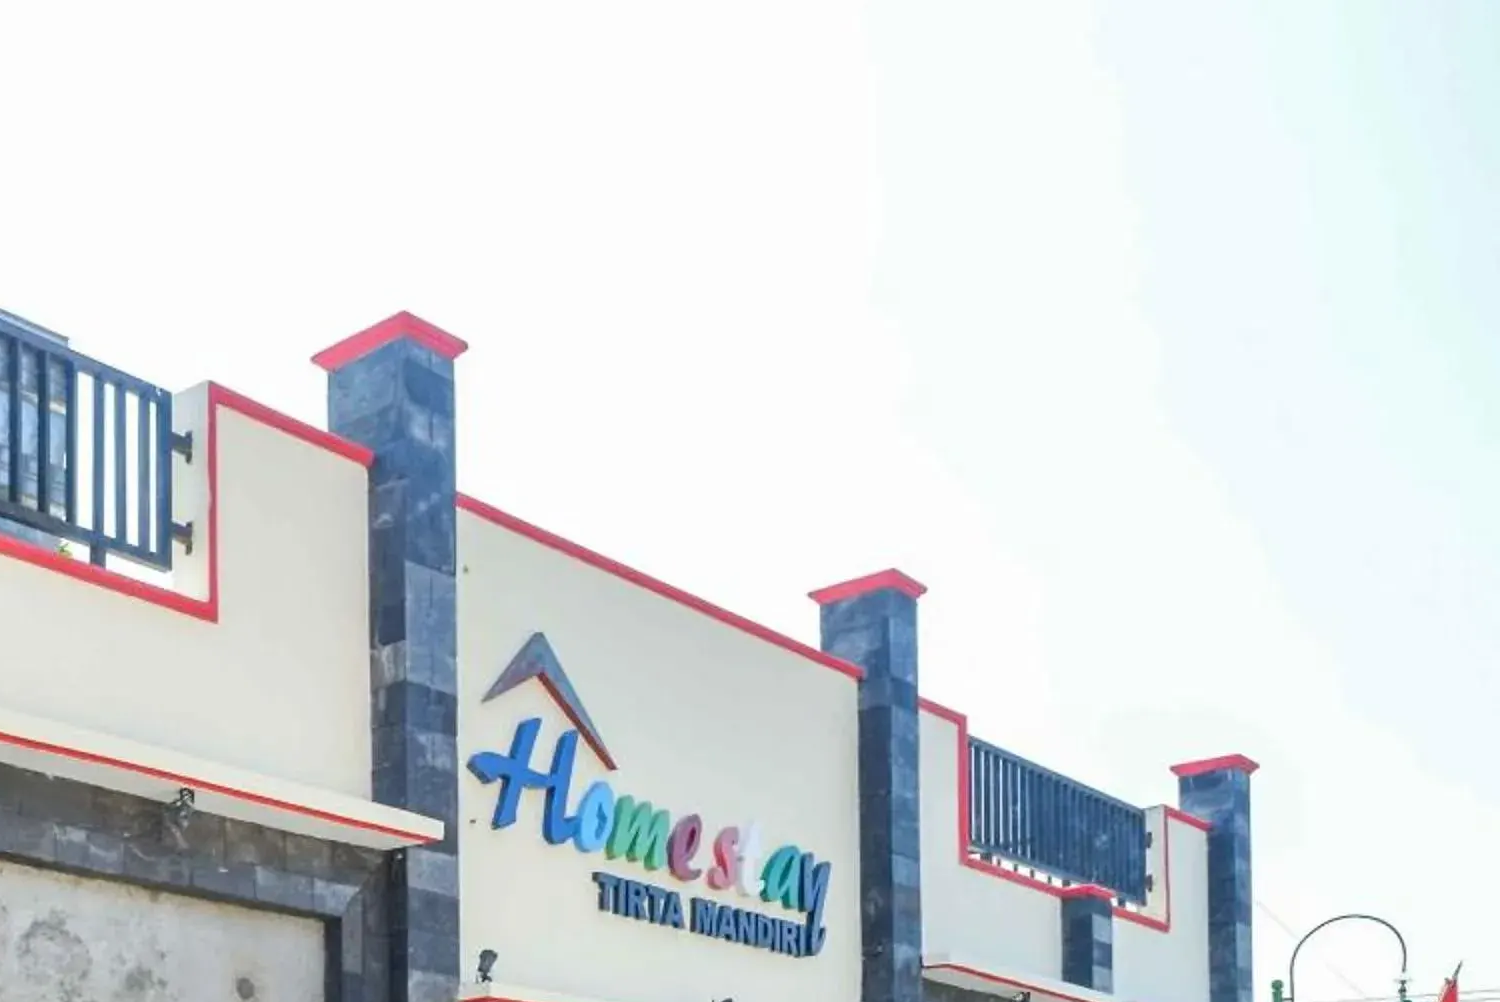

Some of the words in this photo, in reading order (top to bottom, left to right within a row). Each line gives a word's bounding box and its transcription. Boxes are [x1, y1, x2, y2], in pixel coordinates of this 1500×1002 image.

[467, 717, 831, 956] Homestay
[592, 871, 685, 929] TIRTA
[690, 896, 809, 957] MANDIRI
